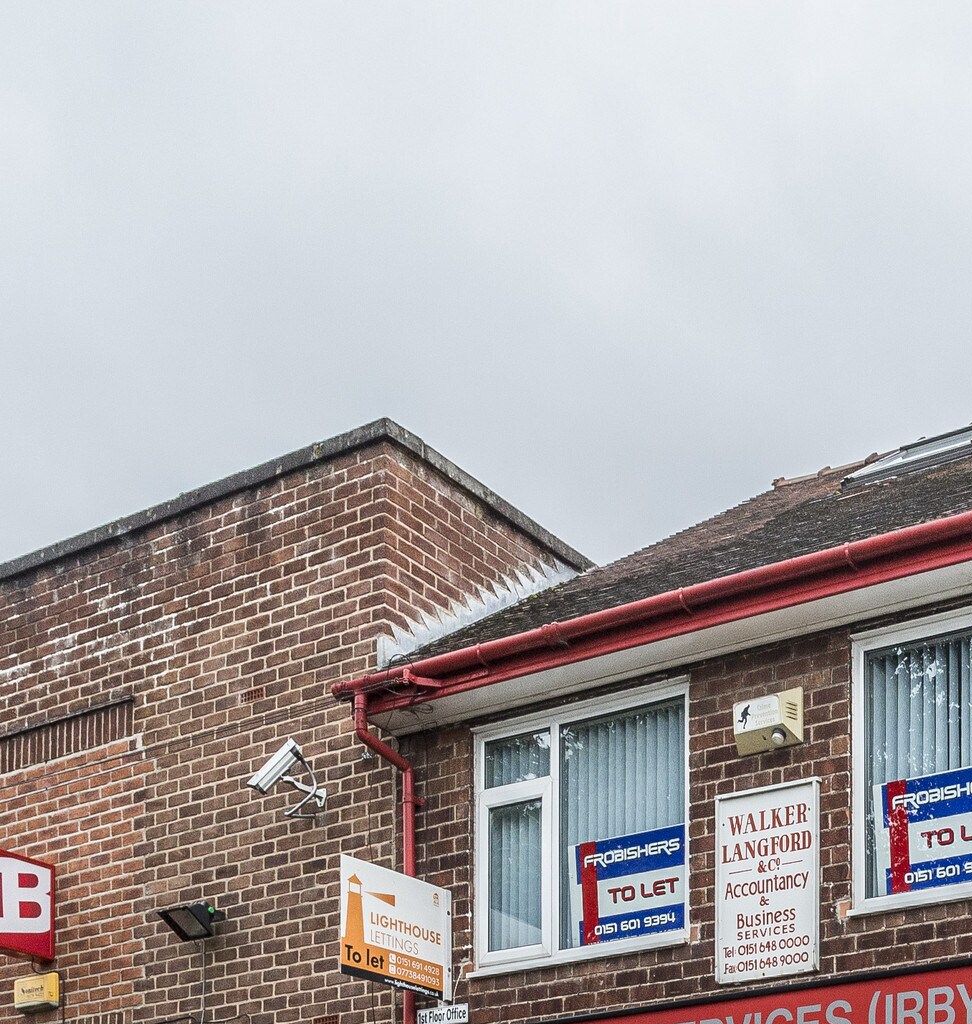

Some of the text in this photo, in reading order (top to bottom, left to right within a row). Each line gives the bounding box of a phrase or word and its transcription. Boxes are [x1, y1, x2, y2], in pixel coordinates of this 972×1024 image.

[728, 802, 809, 836] WALKER
[721, 829, 812, 864] LANGFORD
[921, 827, 953, 848] TO
[583, 837, 681, 869] FROBISHERS
[724, 870, 809, 900] Accountancy
[904, 869, 932, 884] 0151
[936, 864, 962, 879] 601
[608, 877, 680, 904] TO LET
[759, 896, 770, 907] &
[370, 912, 441, 945] LIGHTHOUSE
[594, 911, 676, 936] 0151 601 9394
[737, 907, 796, 930] Business
[370, 929, 419, 956] LETTINGS
[737, 923, 796, 941] SERVICES
[345, 944, 384, 969] To let
[738, 943, 757, 956] 0151
[759, 940, 777, 953] 648
[778, 935, 810, 950] 0000
[396, 956, 411, 968] 0151
[424, 964, 440, 976] 4928
[737, 959, 758, 972] 0151
[759, 956, 778, 969] 648
[780, 951, 809, 967] 9000
[418, 1007, 467, 1024] 1st Floor Office
